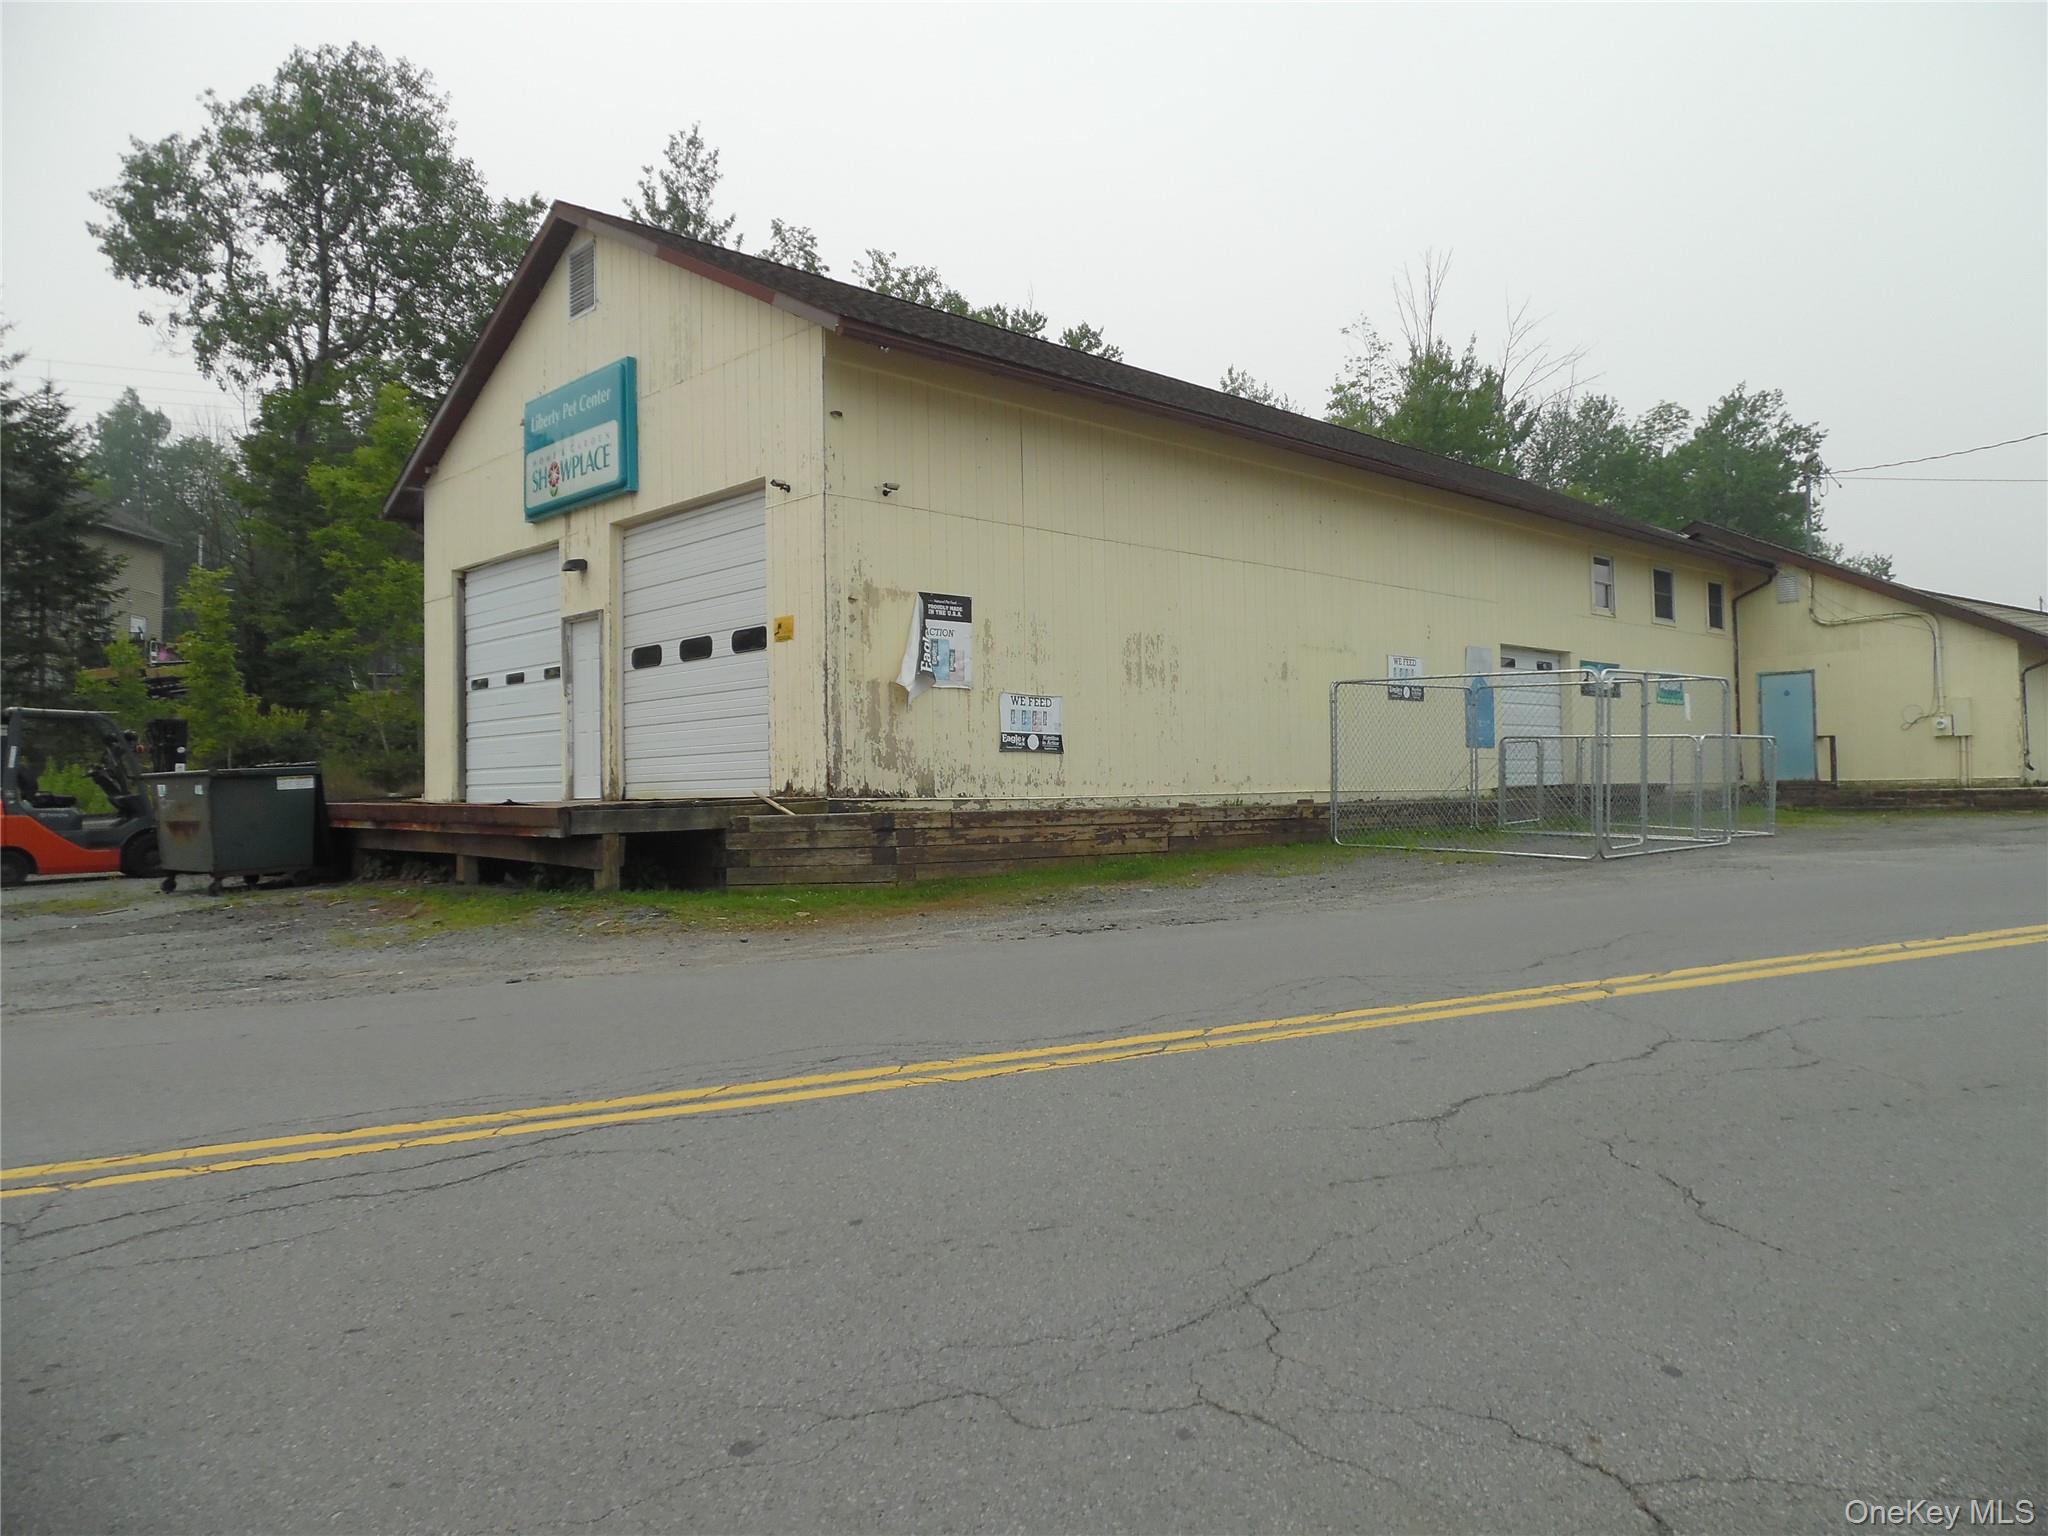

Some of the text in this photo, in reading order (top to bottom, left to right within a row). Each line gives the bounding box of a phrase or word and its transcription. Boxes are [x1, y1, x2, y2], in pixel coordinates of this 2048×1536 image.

[531, 388, 612, 433] Liberty Pet Center
[1010, 695, 1052, 707] WE FEED
[1002, 733, 1021, 744] Eagle
